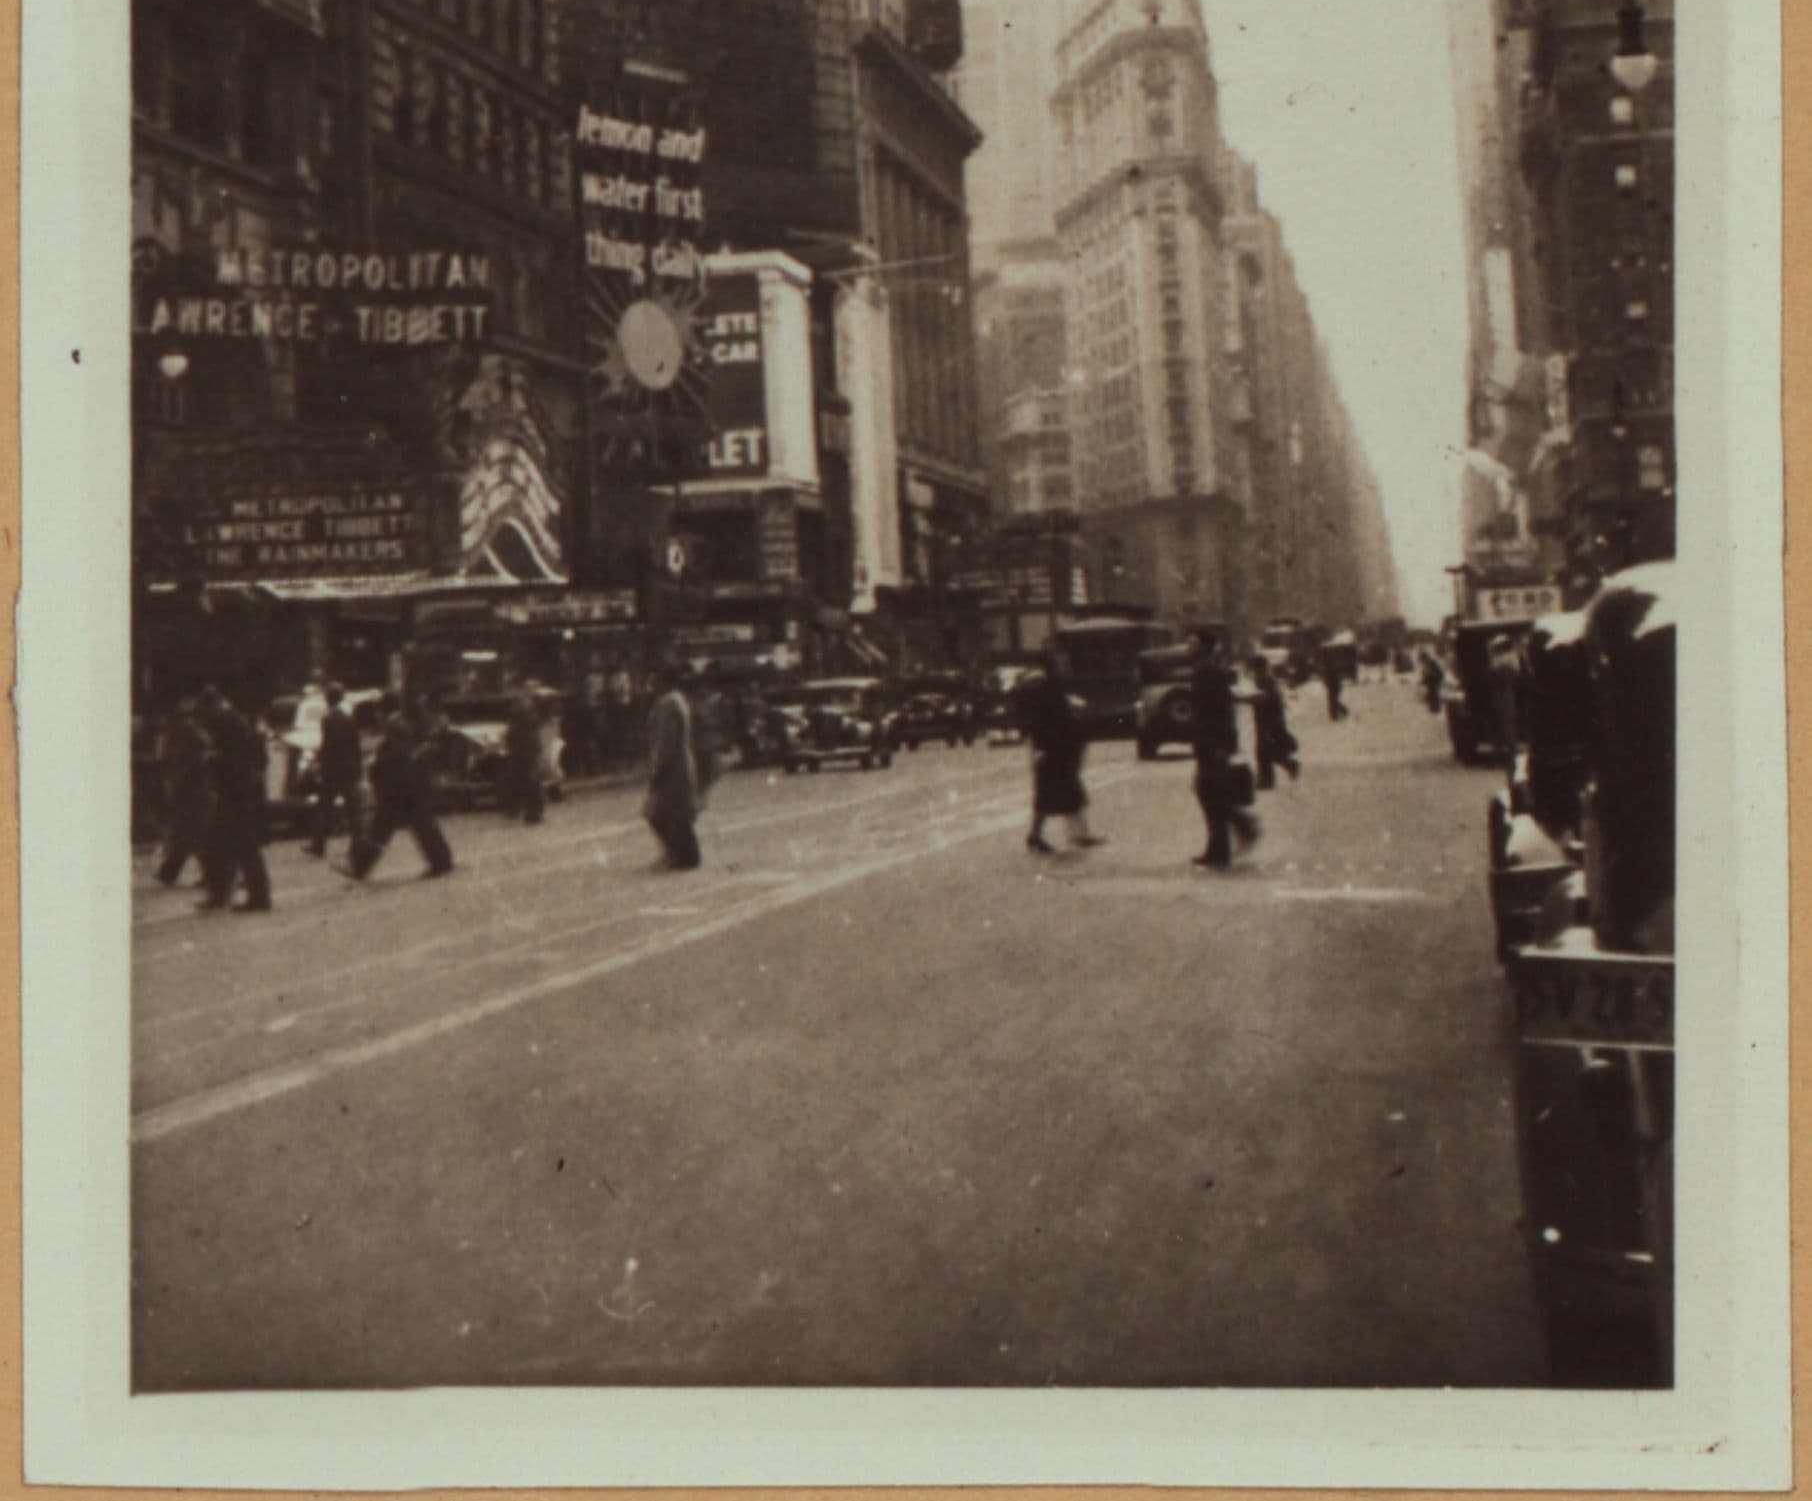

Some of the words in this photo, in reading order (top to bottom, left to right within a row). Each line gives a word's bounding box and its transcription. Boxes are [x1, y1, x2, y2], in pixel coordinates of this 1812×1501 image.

[576, 104, 653, 154] lemon
[657, 127, 706, 164] and
[582, 173, 650, 213] water
[655, 174, 703, 221] first
[217, 250, 490, 290] METROPOLITAN
[585, 229, 646, 286] thing
[711, 339, 760, 366] CAR
